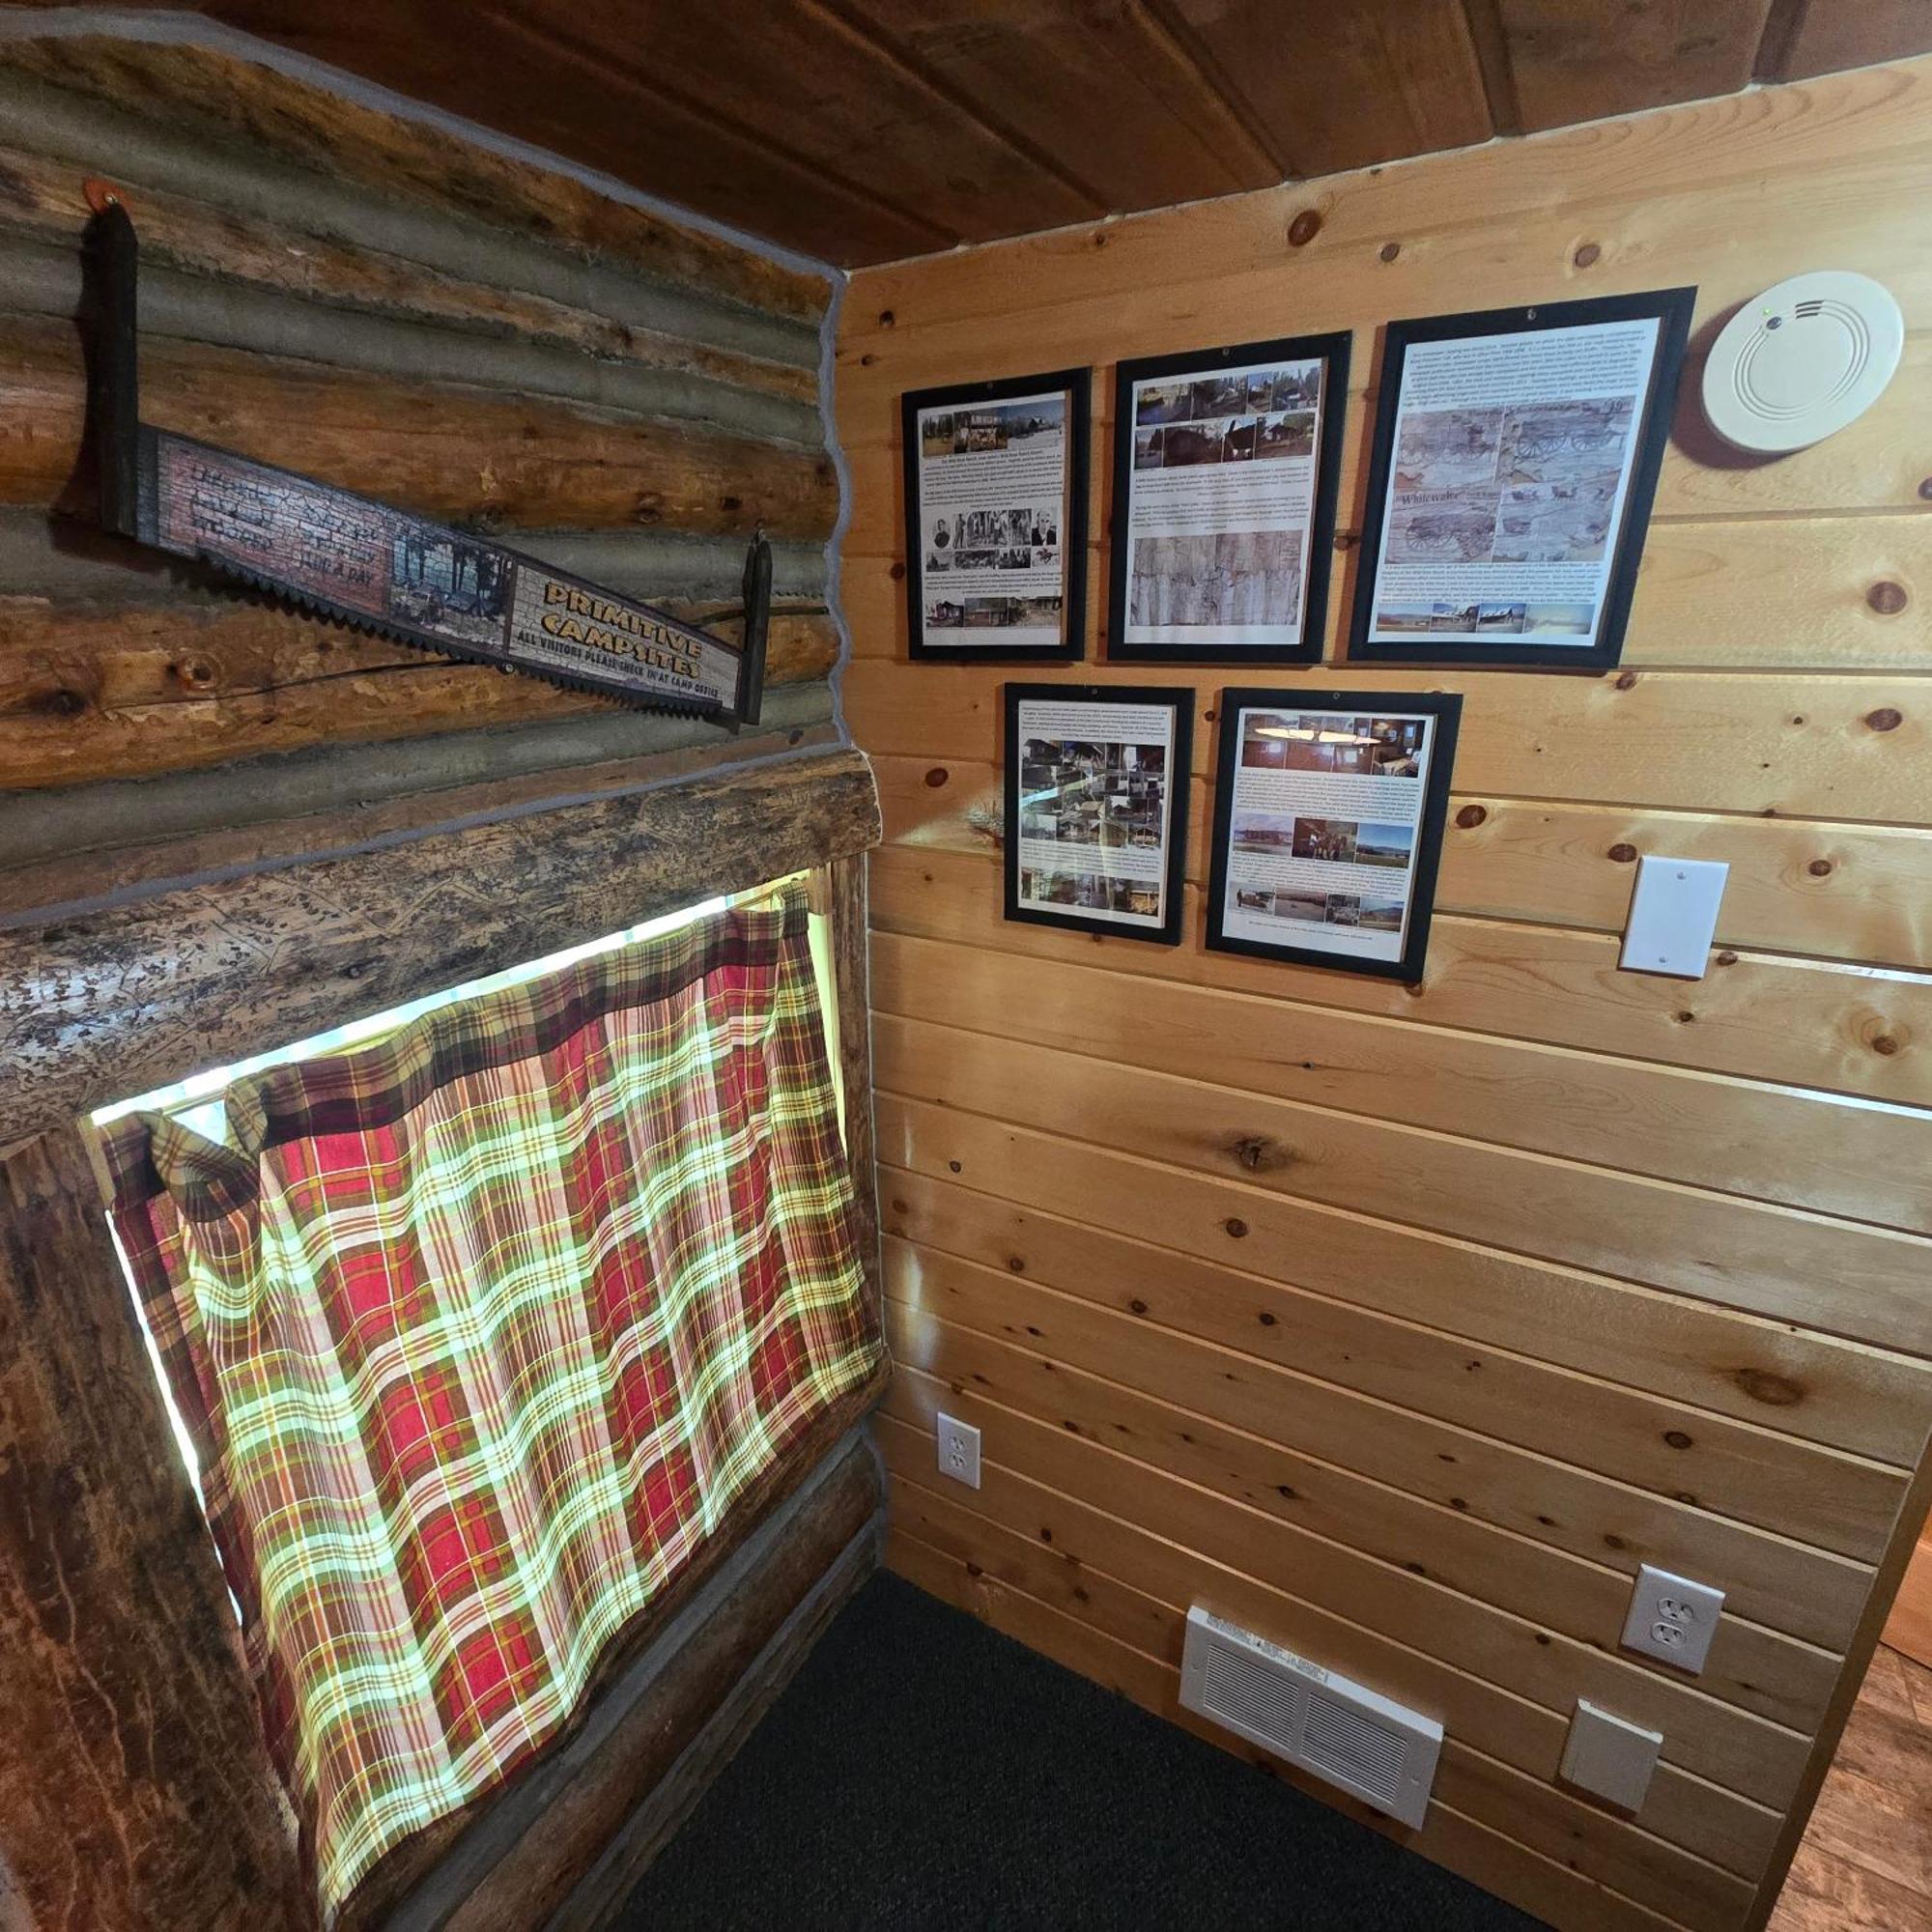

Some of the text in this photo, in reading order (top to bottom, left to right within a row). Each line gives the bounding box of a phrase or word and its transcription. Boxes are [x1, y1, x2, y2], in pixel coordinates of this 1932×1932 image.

[517, 630, 537, 646] ALL
[541, 612, 702, 679] CAMPSITES
[544, 582, 703, 660] PRIMITIVE
